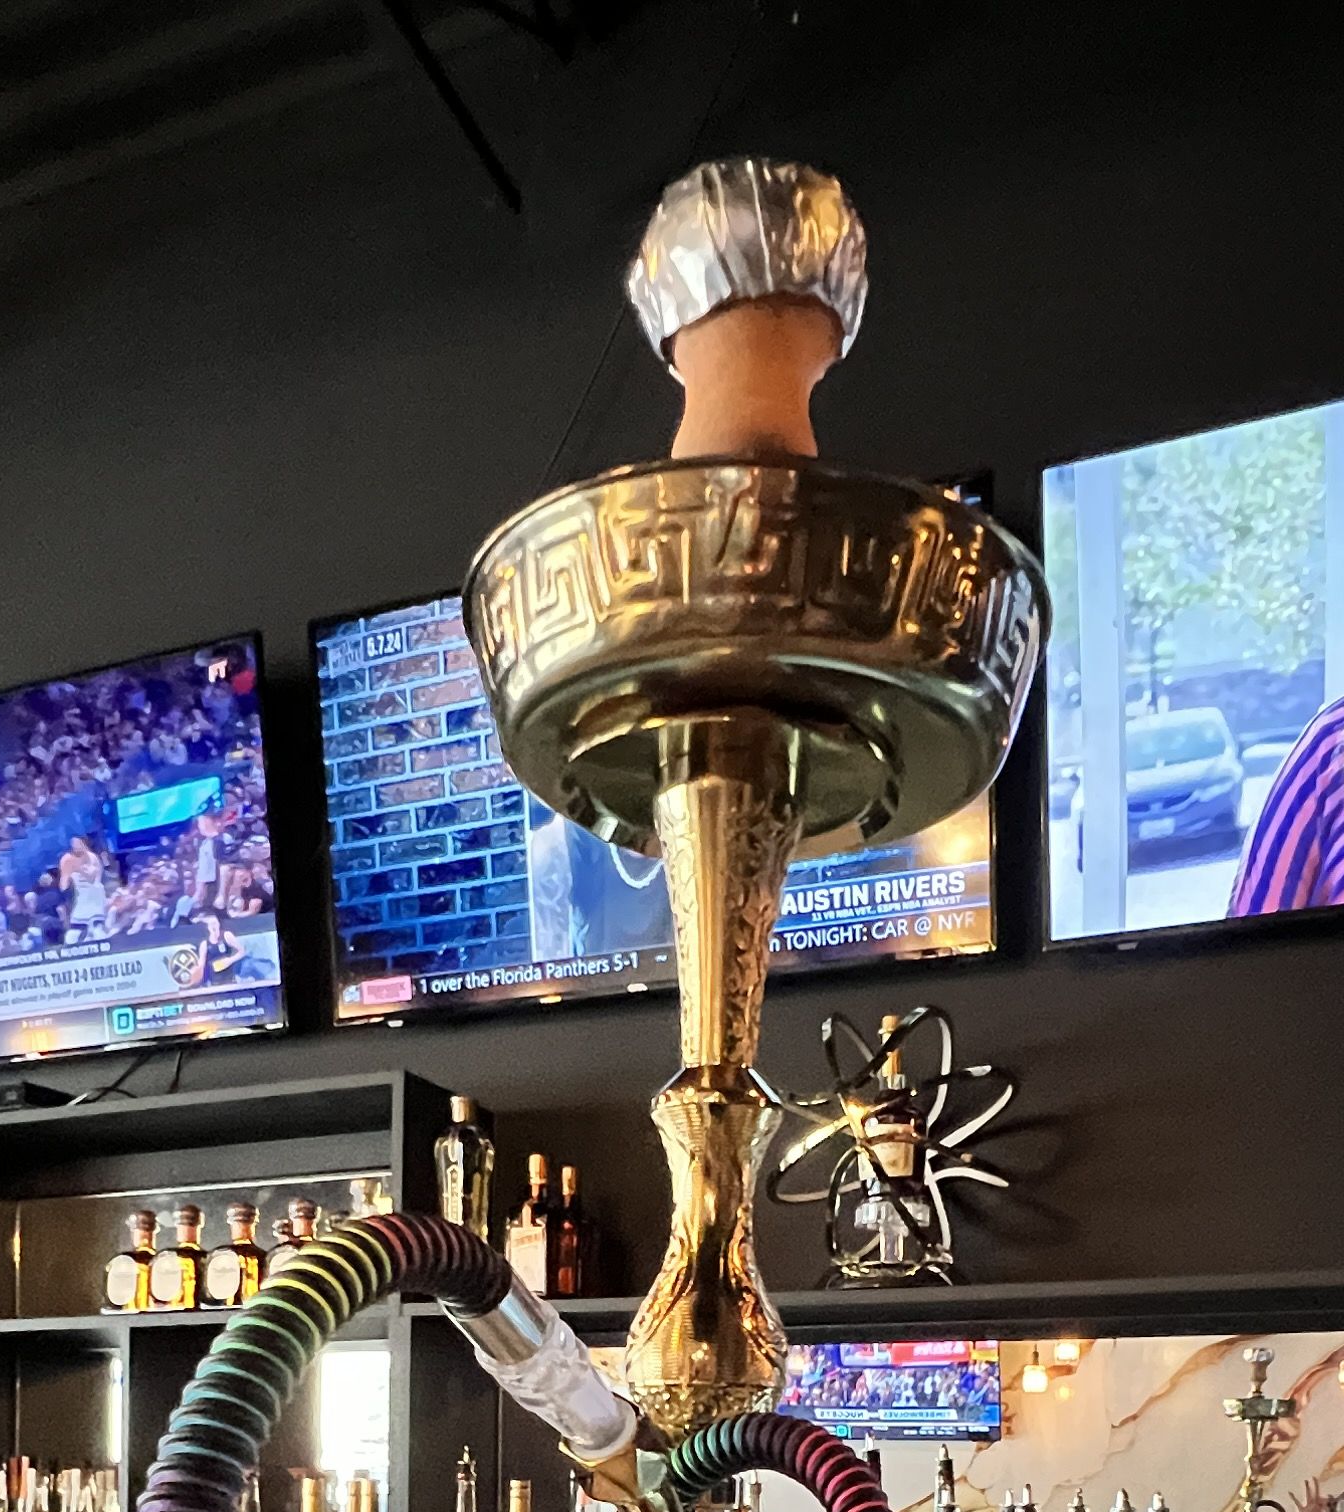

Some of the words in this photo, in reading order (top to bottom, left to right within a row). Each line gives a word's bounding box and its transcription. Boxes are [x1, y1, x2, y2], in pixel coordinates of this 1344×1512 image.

[781, 883, 870, 916] AUSTIN
[875, 871, 966, 903] RIVERS
[783, 924, 868, 951] TONIGHT:
[871, 918, 909, 940] CAR
[52, 969, 73, 986] TAKE
[90, 962, 119, 981] SERIES
[120, 960, 143, 976] LEAD
[431, 975, 463, 993] over
[465, 970, 490, 988] the
[492, 965, 543, 986] Florida
[545, 957, 610, 980] Panthers
[613, 951, 639, 971] 5-1
